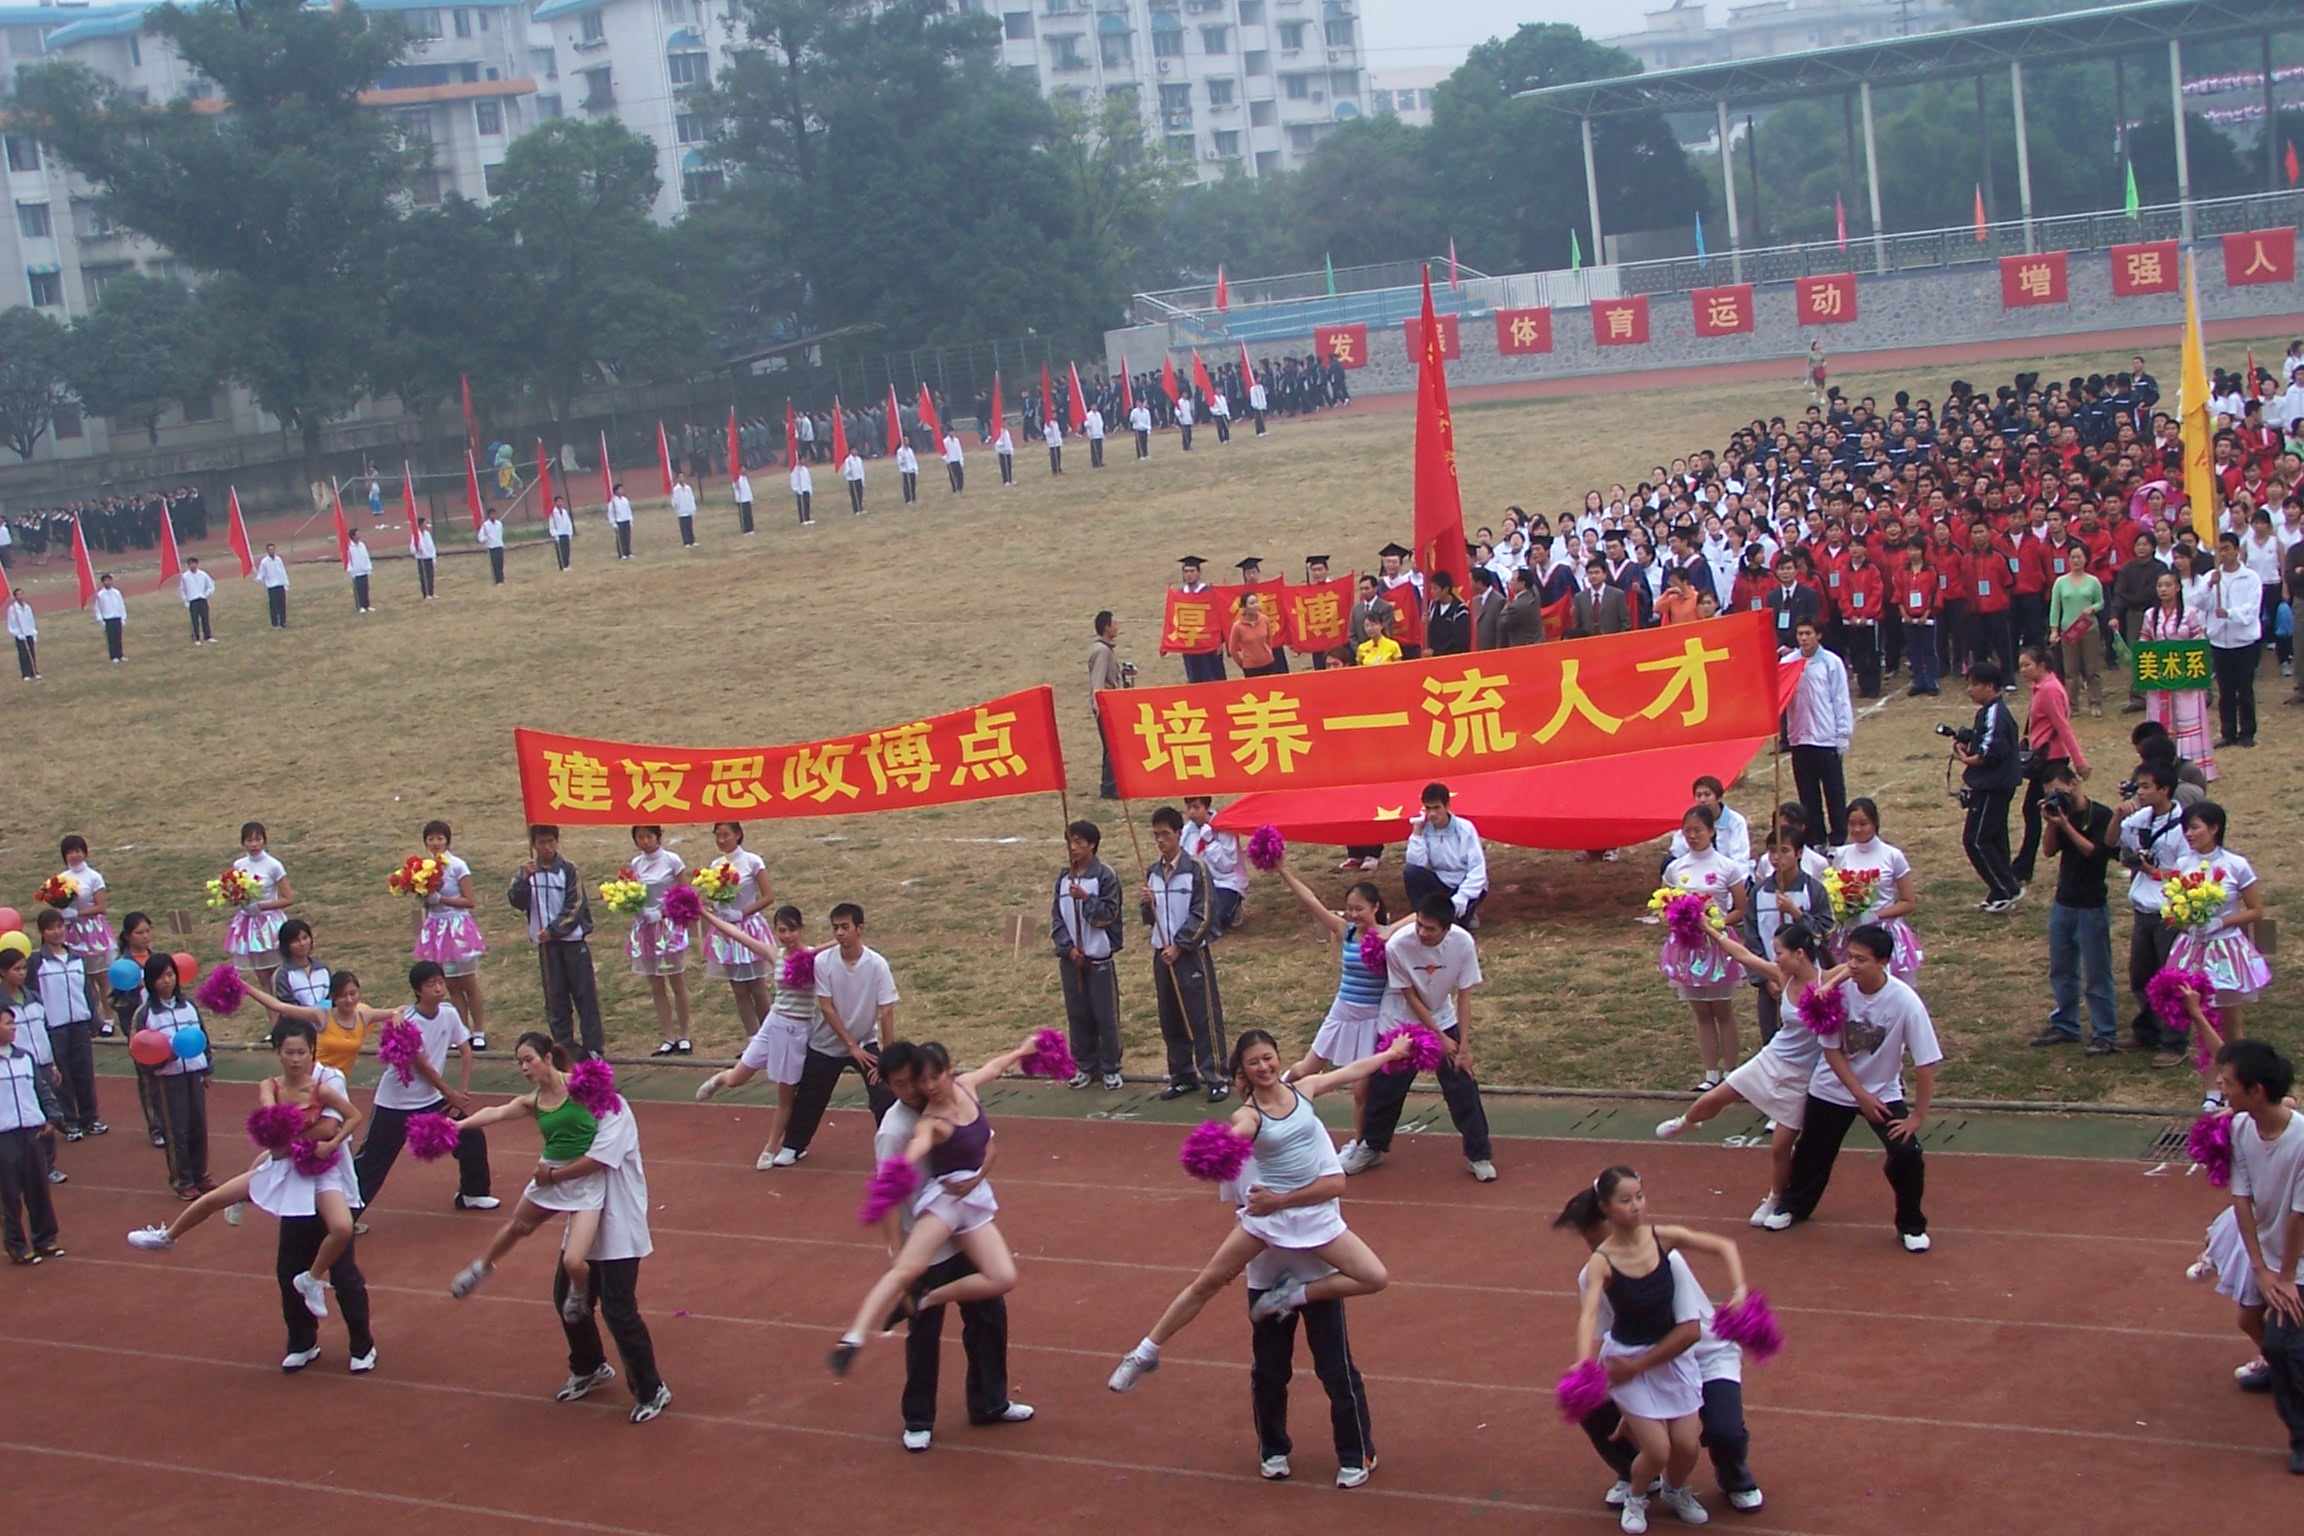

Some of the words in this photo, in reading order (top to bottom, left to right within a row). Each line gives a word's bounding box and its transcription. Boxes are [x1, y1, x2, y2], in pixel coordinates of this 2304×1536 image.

[1329, 333, 1354, 364] 发
[1510, 317, 1538, 347] 体
[1606, 307, 1636, 338] 育
[1709, 296, 1738, 328] 运
[1811, 283, 1841, 316] 动
[2019, 263, 2051, 297] 增
[2128, 252, 2162, 286] 强
[2245, 240, 2277, 277] 人
[1168, 603, 1211, 647] 厚
[1292, 591, 1345, 641] 博
[2138, 650, 2206, 681] 美术系
[543, 708, 1028, 812] 建设思政博点
[1133, 637, 1730, 780] 培养一流人才
